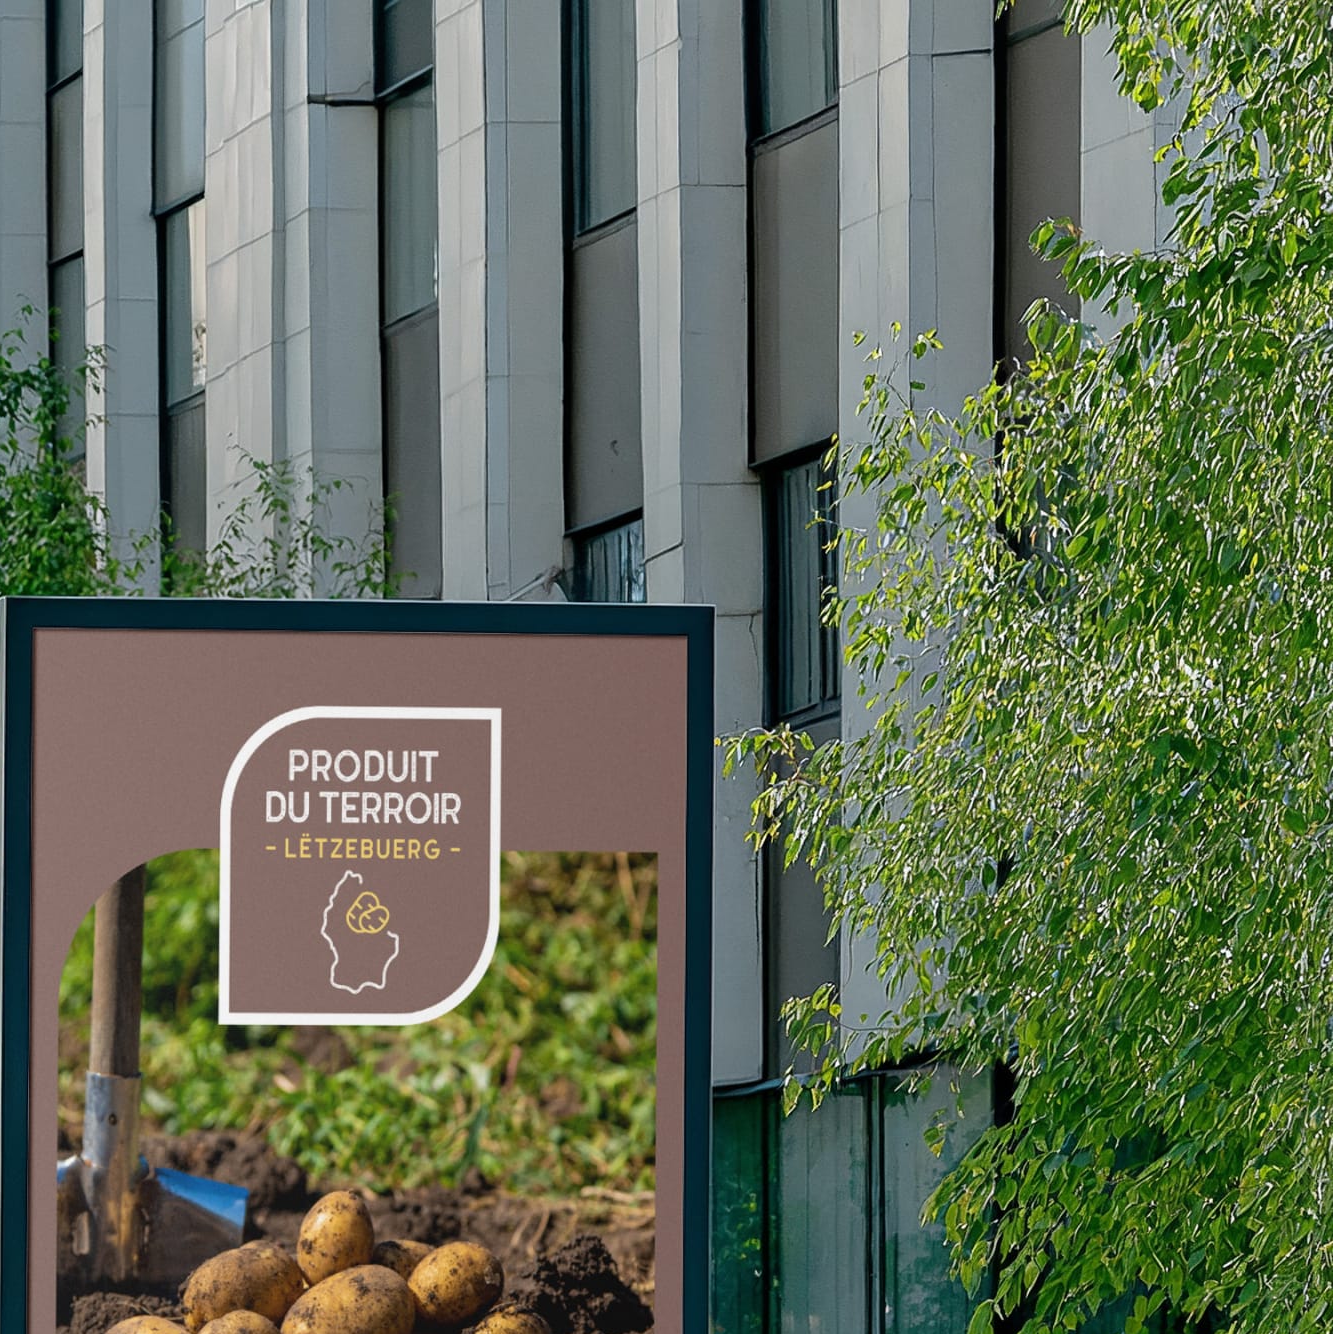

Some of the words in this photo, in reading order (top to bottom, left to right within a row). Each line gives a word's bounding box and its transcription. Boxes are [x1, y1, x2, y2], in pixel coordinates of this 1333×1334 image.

[288, 748, 439, 783] PRODUIT
[265, 790, 310, 824] DU
[318, 791, 462, 825] TERROIR
[284, 832, 441, 860] LËTZEBUERG
